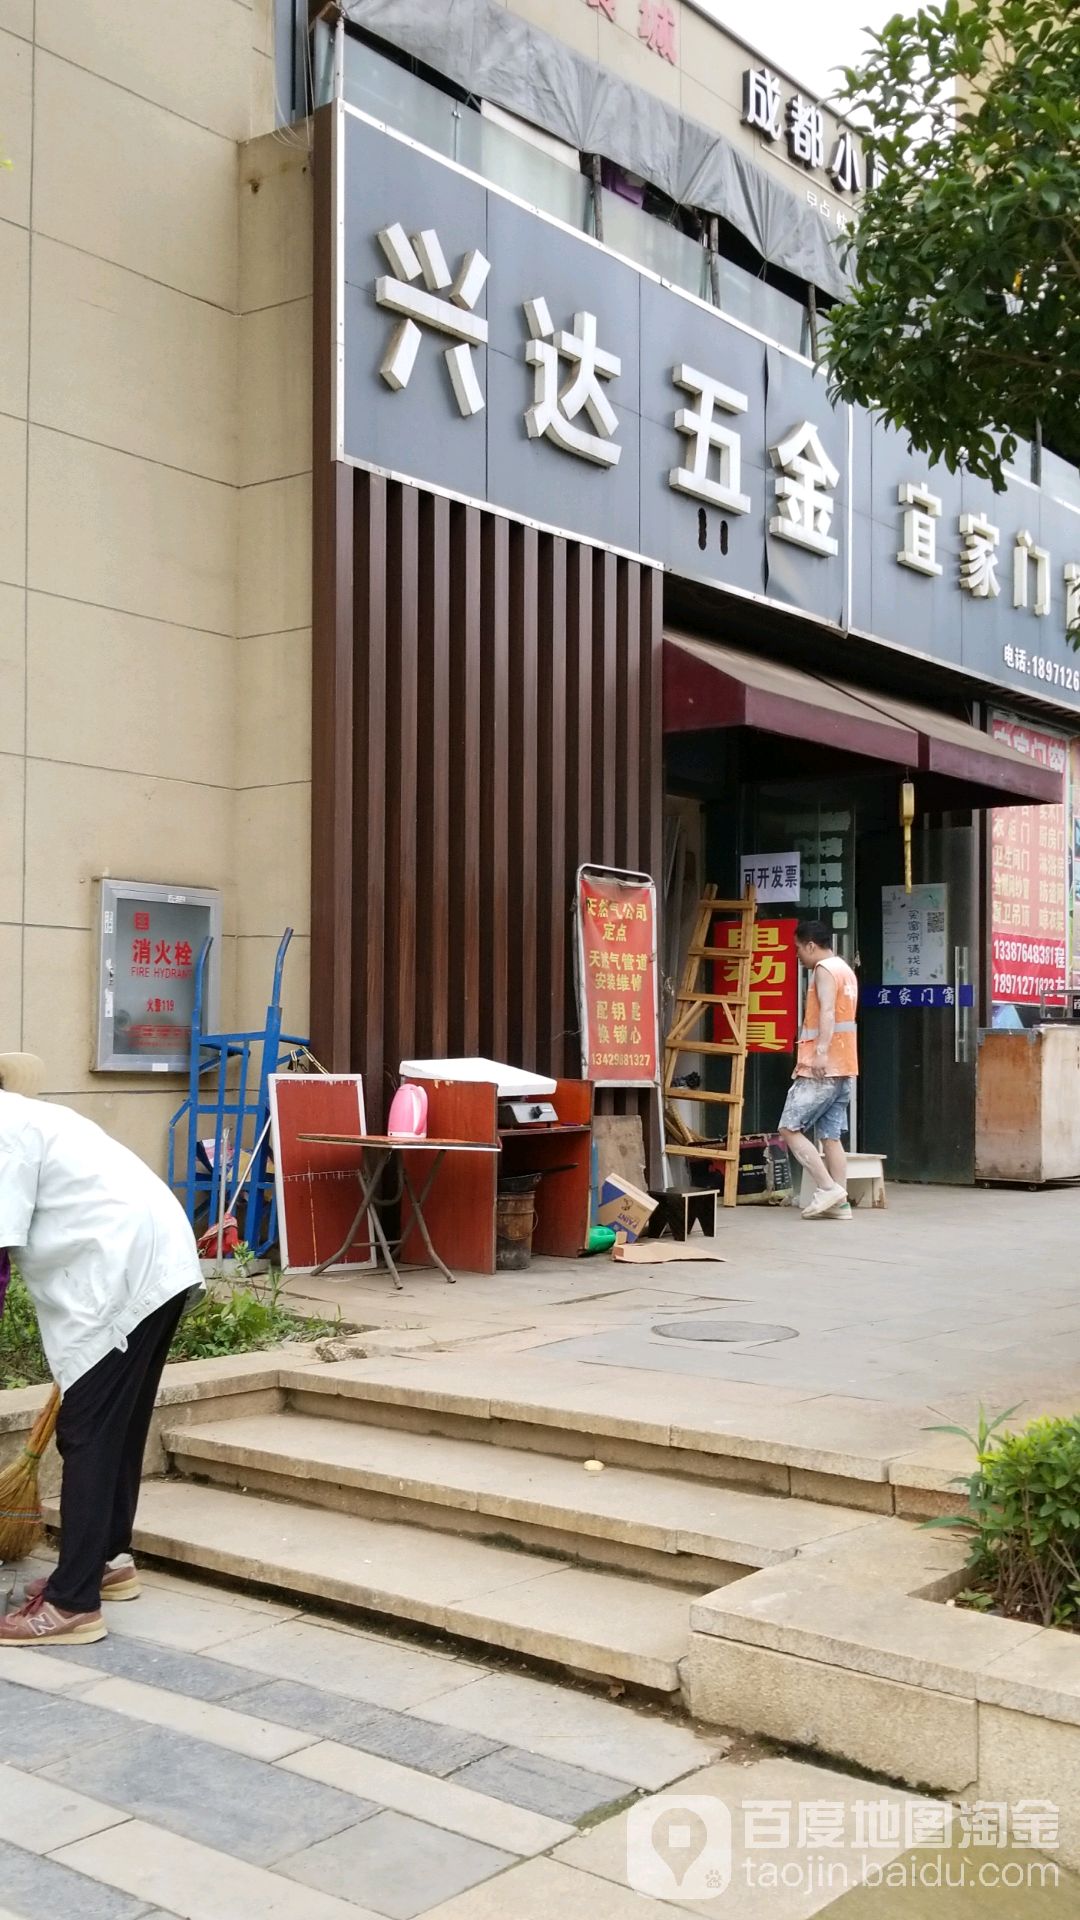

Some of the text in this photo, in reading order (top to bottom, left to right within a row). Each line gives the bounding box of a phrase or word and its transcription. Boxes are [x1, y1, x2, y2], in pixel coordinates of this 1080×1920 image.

[375, 221, 840, 557] 兴达五金
[993, 845, 1030, 872] 卫生间门
[743, 864, 798, 888] 可开发票
[587, 897, 648, 921] 天然气公司
[602, 922, 627, 942] 定点
[132, 938, 193, 966] 消火栓
[589, 950, 648, 971] 天然气管道
[131, 966, 193, 980] FIRE HYDRANT
[595, 972, 642, 991] 安装维修
[721, 923, 789, 1050] 电动工具
[878, 986, 955, 1005] 宜家门窗
[146, 997, 175, 1013] 火警119
[596, 1000, 641, 1021] 配钥匙
[598, 1022, 641, 1044] 换锁心
